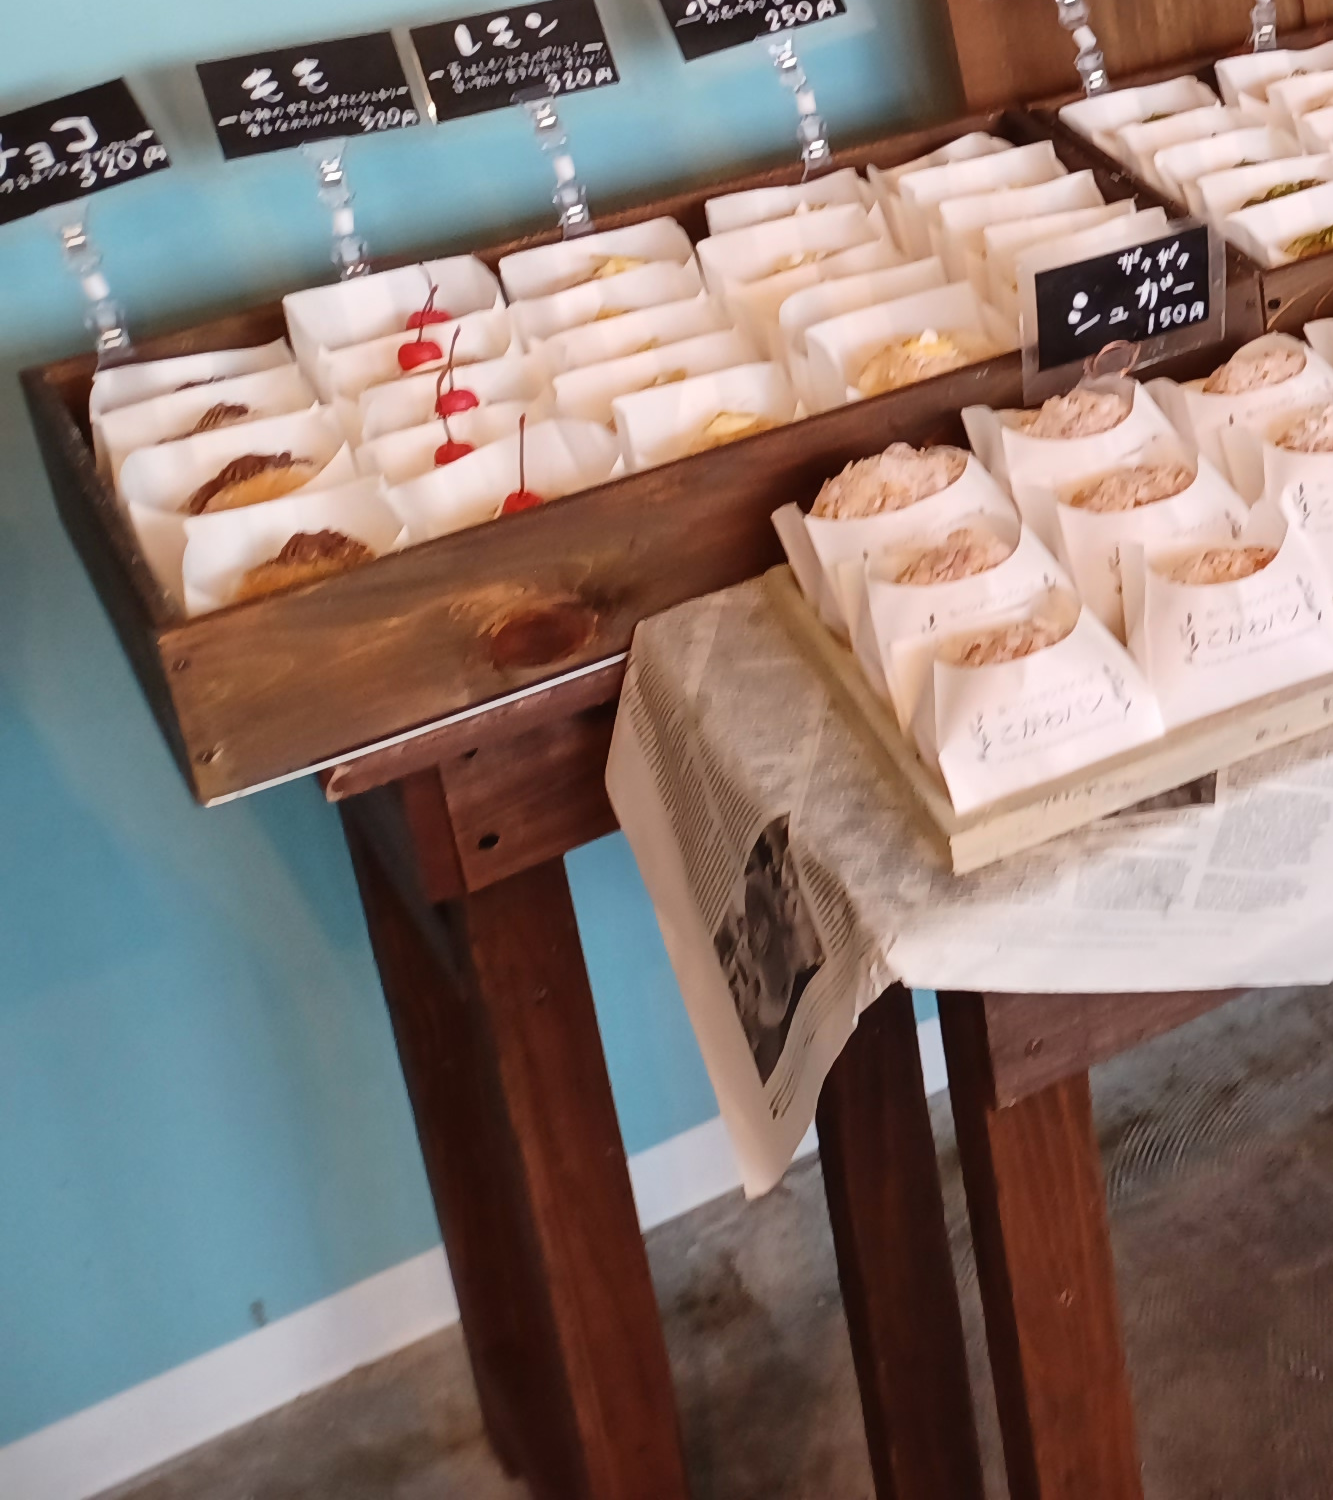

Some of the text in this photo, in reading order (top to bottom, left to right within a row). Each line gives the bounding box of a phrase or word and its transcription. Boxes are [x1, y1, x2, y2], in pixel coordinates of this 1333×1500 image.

[454, 11, 559, 57] レモン
[545, 66, 613, 95] 320円
[1067, 271, 1195, 337] シュガー
[1148, 300, 1205, 334] 150円
